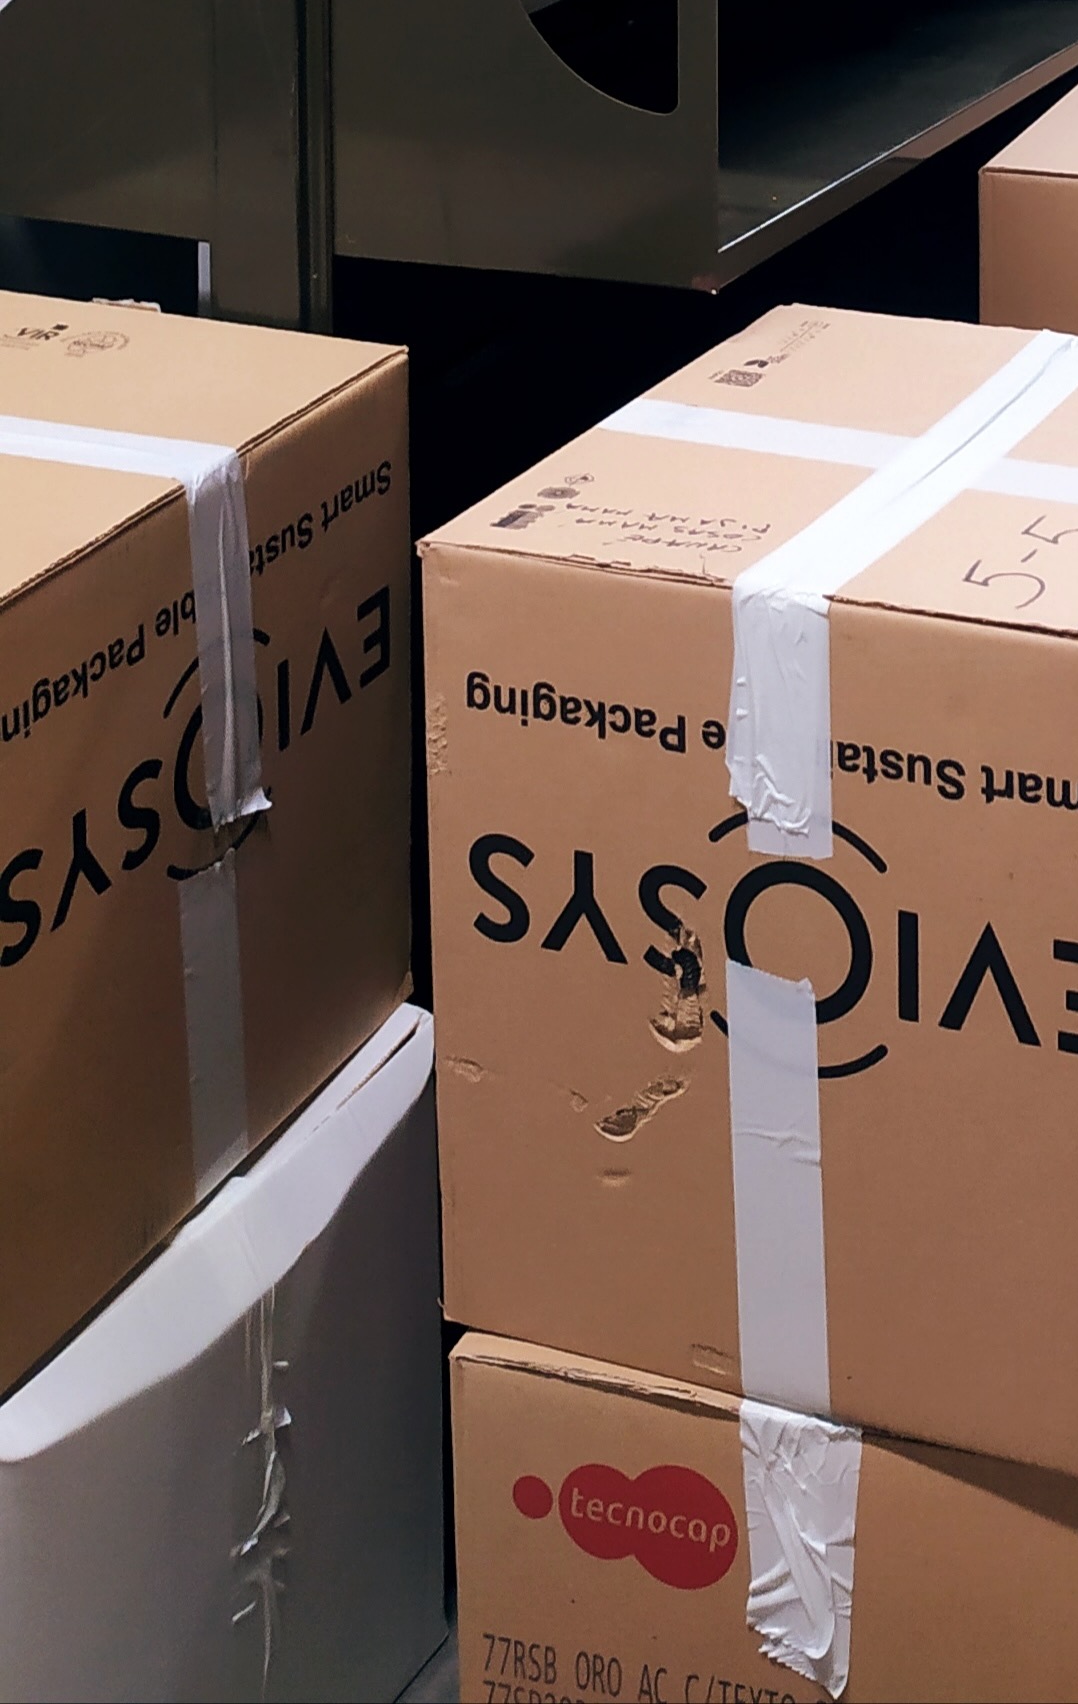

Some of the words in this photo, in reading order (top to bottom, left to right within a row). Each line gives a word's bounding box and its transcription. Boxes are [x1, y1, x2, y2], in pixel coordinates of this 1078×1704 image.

[321, 460, 393, 534] Smart
[155, 512, 313, 638] Sustble
[0, 623, 145, 743] Packagin
[465, 671, 687, 754] Packaging
[701, 719, 966, 800] Sustae
[570, 1487, 732, 1553] tecnocap
[482, 1632, 558, 1686] 77RSB
[575, 1650, 623, 1698] ORO
[638, 1662, 668, 1704] AC
